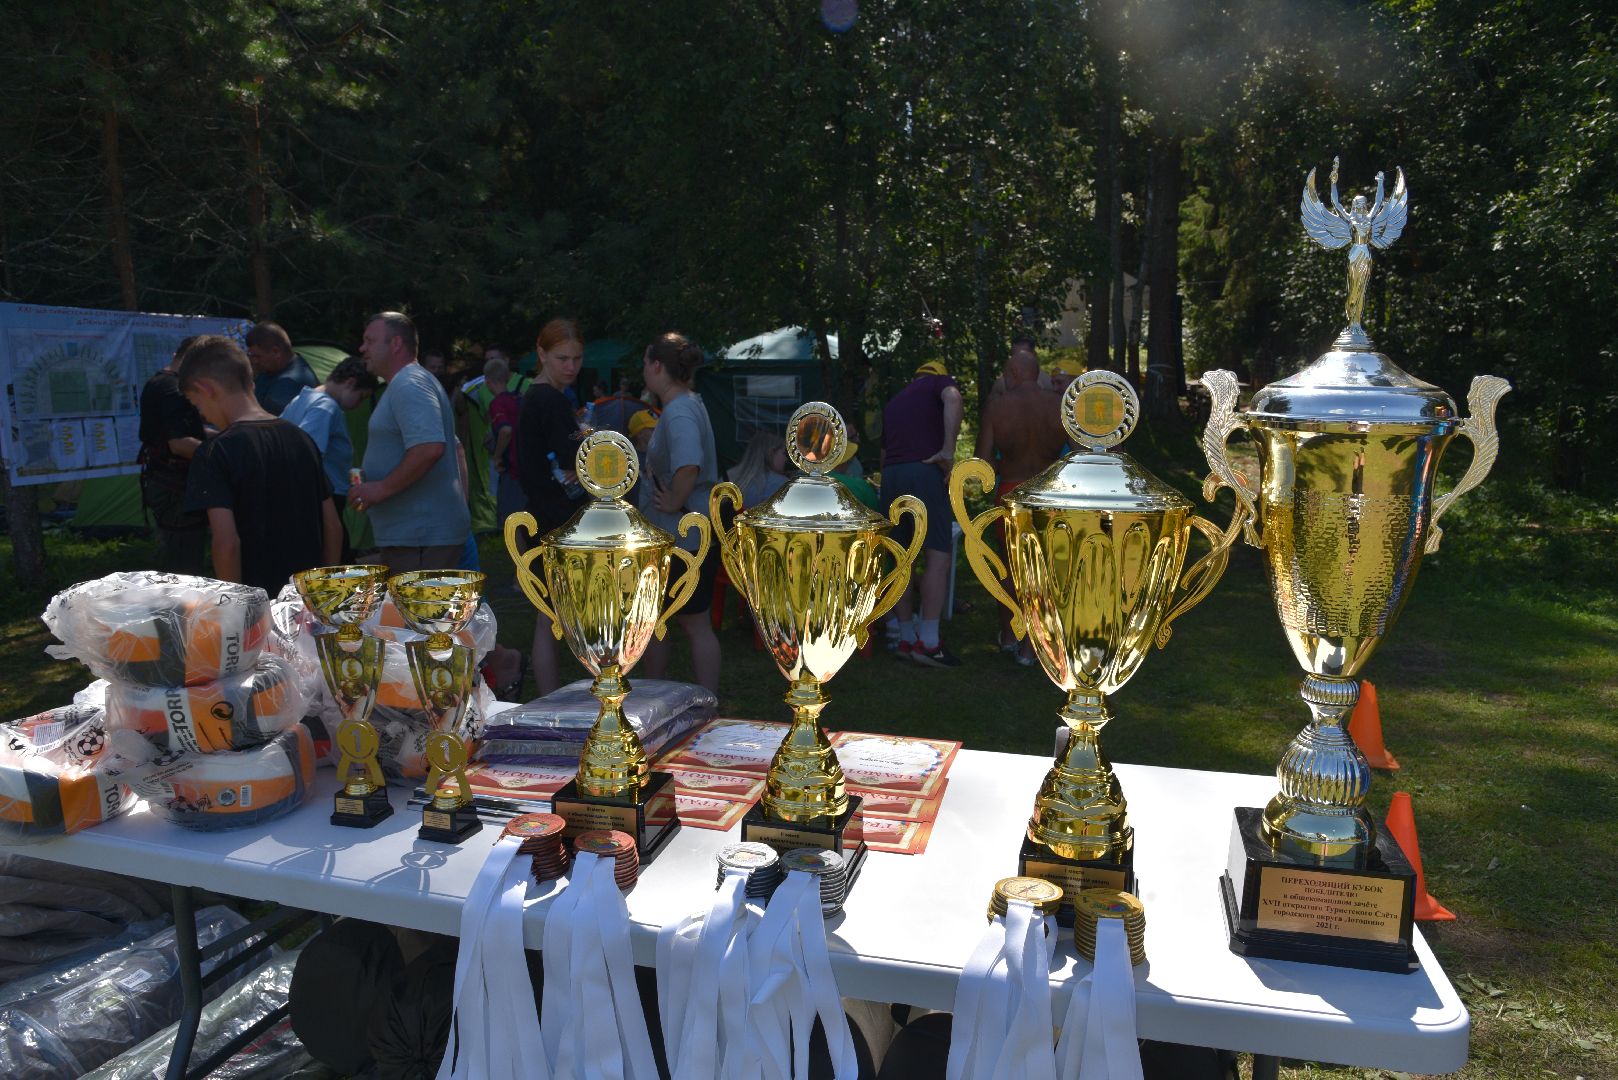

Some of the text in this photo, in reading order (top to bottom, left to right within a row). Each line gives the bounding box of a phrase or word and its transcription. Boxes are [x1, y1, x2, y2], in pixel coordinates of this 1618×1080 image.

[352, 729, 361, 752] 1
[439, 739, 450, 763] 1
[1281, 876, 1384, 894] ПЕРЕХОДЯЩИЙ КУБОК
[1315, 921, 1332, 930] 2021
